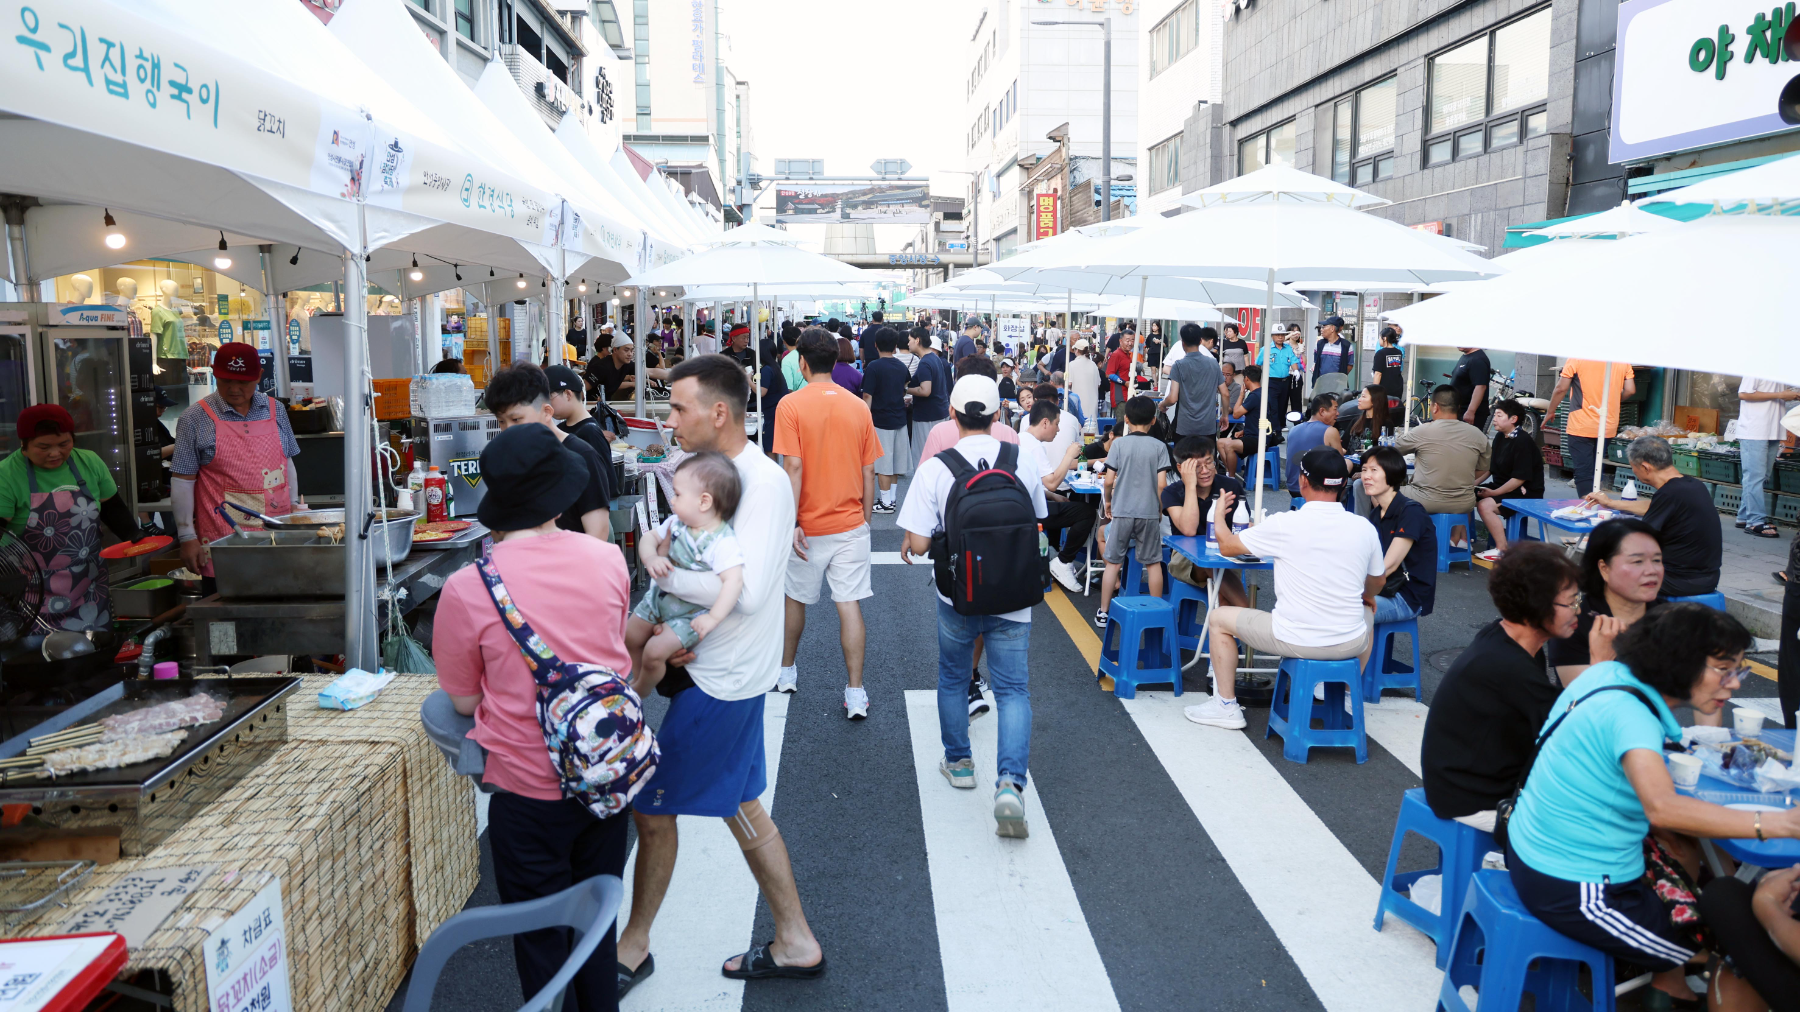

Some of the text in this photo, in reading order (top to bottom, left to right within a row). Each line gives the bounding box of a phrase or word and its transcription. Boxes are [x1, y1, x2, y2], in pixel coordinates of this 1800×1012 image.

[1689, 1, 1796, 81] 야채
[15, 6, 220, 129] 우리집행국이
[257, 109, 286, 139] 닭꼬치
[478, 182, 515, 219] 한경식당
[888, 254, 928, 265] 중앙시장
[79, 312, 116, 323] Aqua FINE
[1003, 325, 1025, 333] 화장실
[242, 907, 273, 949] 차림표
